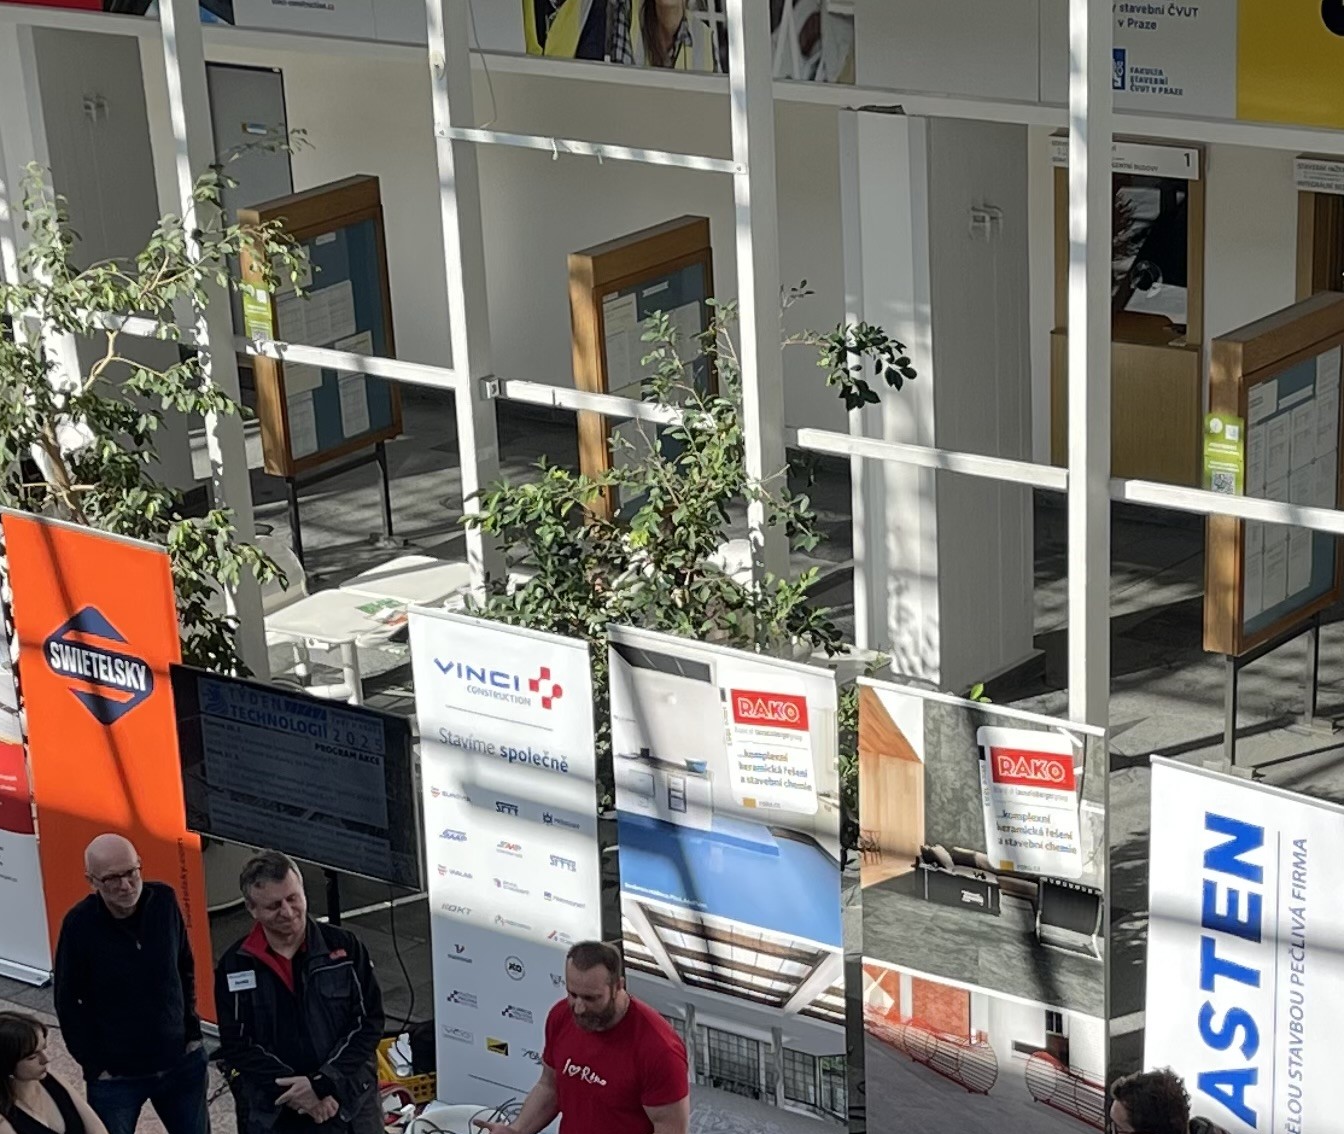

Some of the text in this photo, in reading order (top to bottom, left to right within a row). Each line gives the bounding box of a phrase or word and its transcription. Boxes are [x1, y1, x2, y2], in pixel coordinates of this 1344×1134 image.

[1127, 17, 1157, 30] Praze
[1167, 2, 1199, 17] ČVUT
[1183, 152, 1191, 168] 1
[49, 641, 147, 692] SWIETELSKY
[434, 657, 520, 692] VINCI
[466, 684, 532, 707] CONSTRUCTION
[737, 697, 801, 723] RAKO
[230, 704, 328, 739] TECHNOLOGII
[438, 726, 569, 773] Stavíme společně
[997, 755, 1066, 783] RAKO
[1292, 838, 1309, 903] FIRMA
[1286, 908, 1307, 986] PEČLIVÁ
[1288, 1010, 1305, 1082] STAVBOU
